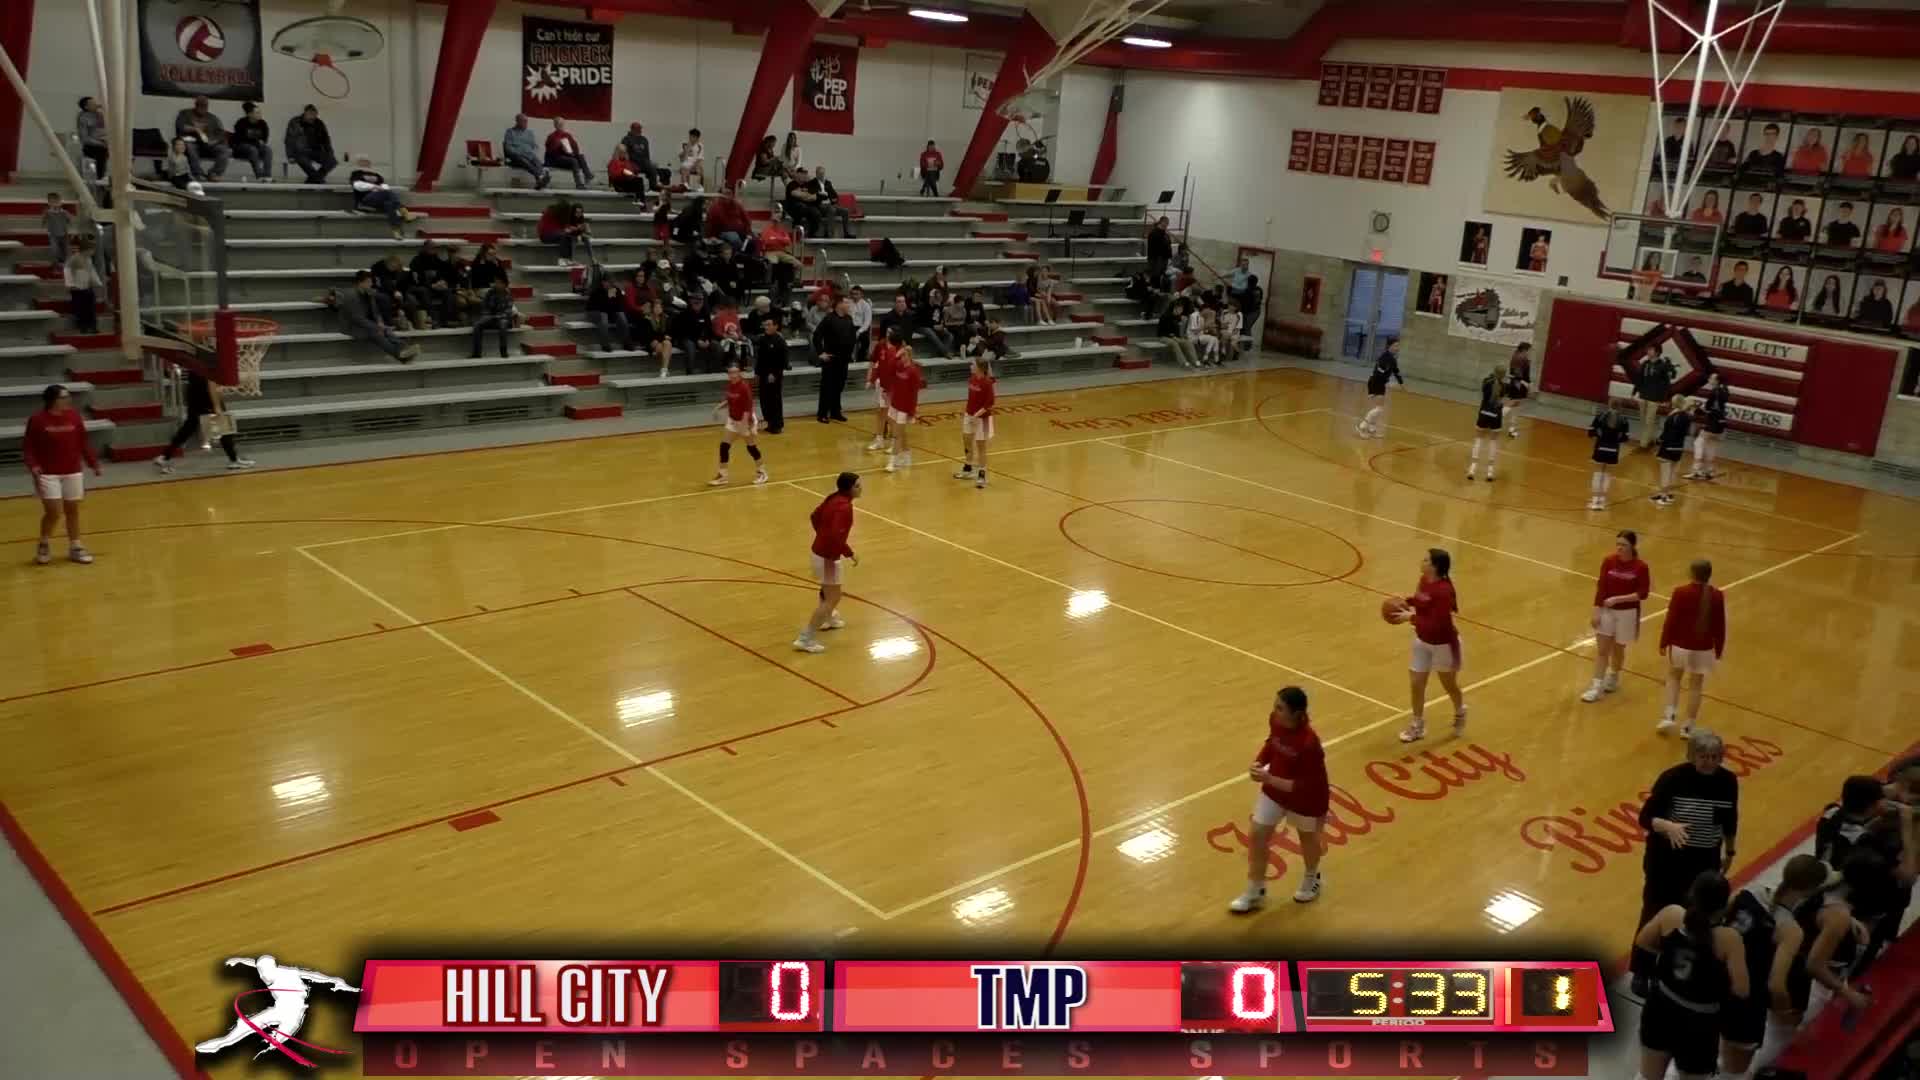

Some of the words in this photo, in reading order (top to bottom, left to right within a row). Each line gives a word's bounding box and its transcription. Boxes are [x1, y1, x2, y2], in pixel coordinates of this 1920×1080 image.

[530, 43, 612, 66] RINGNECK
[160, 63, 256, 86] VOLLEYBALL
[558, 67, 612, 86] PRIDE
[823, 78, 847, 95] PEP
[814, 94, 846, 111] CLUB
[1711, 334, 1745, 352] HILL
[1753, 342, 1792, 358] CITY
[1365, 743, 1526, 801] City
